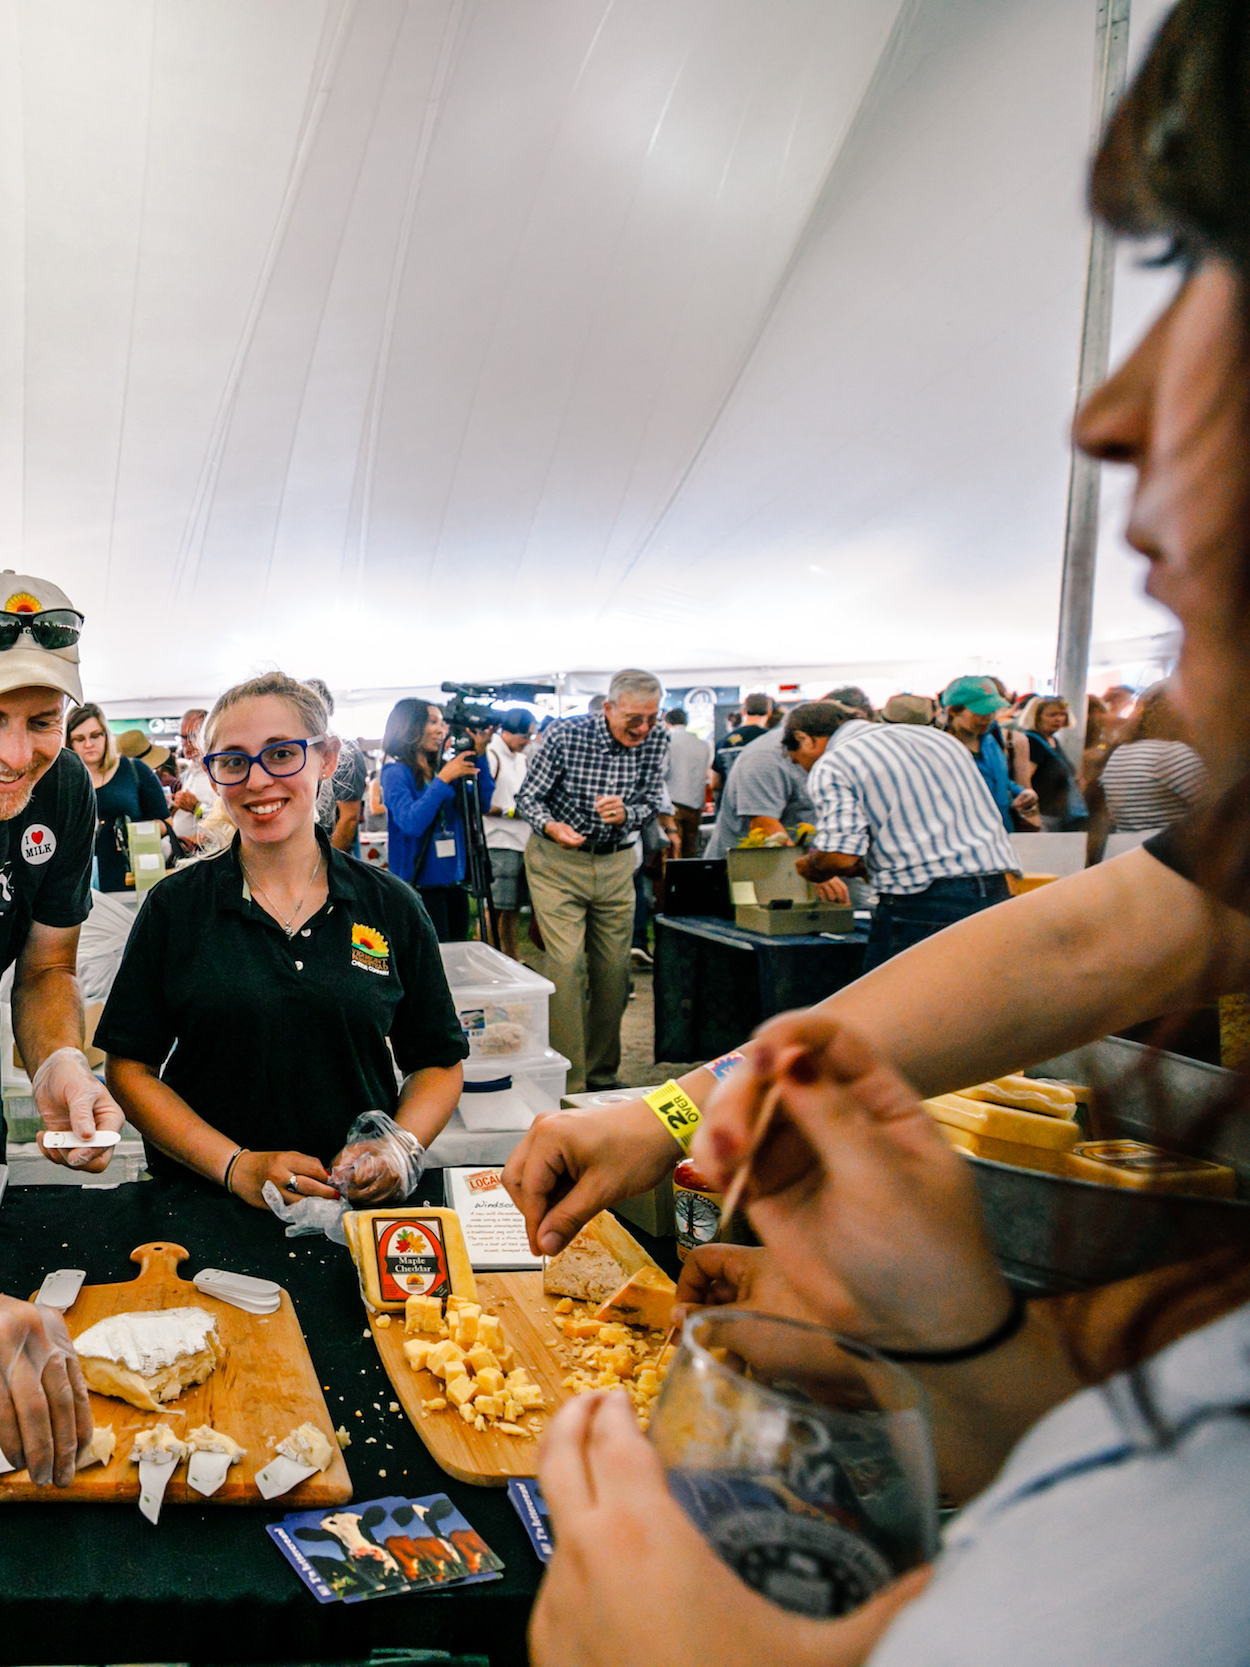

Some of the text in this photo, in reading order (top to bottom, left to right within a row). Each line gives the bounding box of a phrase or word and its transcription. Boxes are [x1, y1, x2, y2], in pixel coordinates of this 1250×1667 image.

[25, 835, 29, 846] I
[25, 843, 52, 858] MILK
[673, 1094, 699, 1123] OVER
[658, 1101, 689, 1130] 21
[469, 1174, 502, 1189] LOCAL
[474, 1200, 515, 1209] Windsor
[399, 1257, 426, 1265] Maple
[394, 1264, 432, 1273] Cheddar
